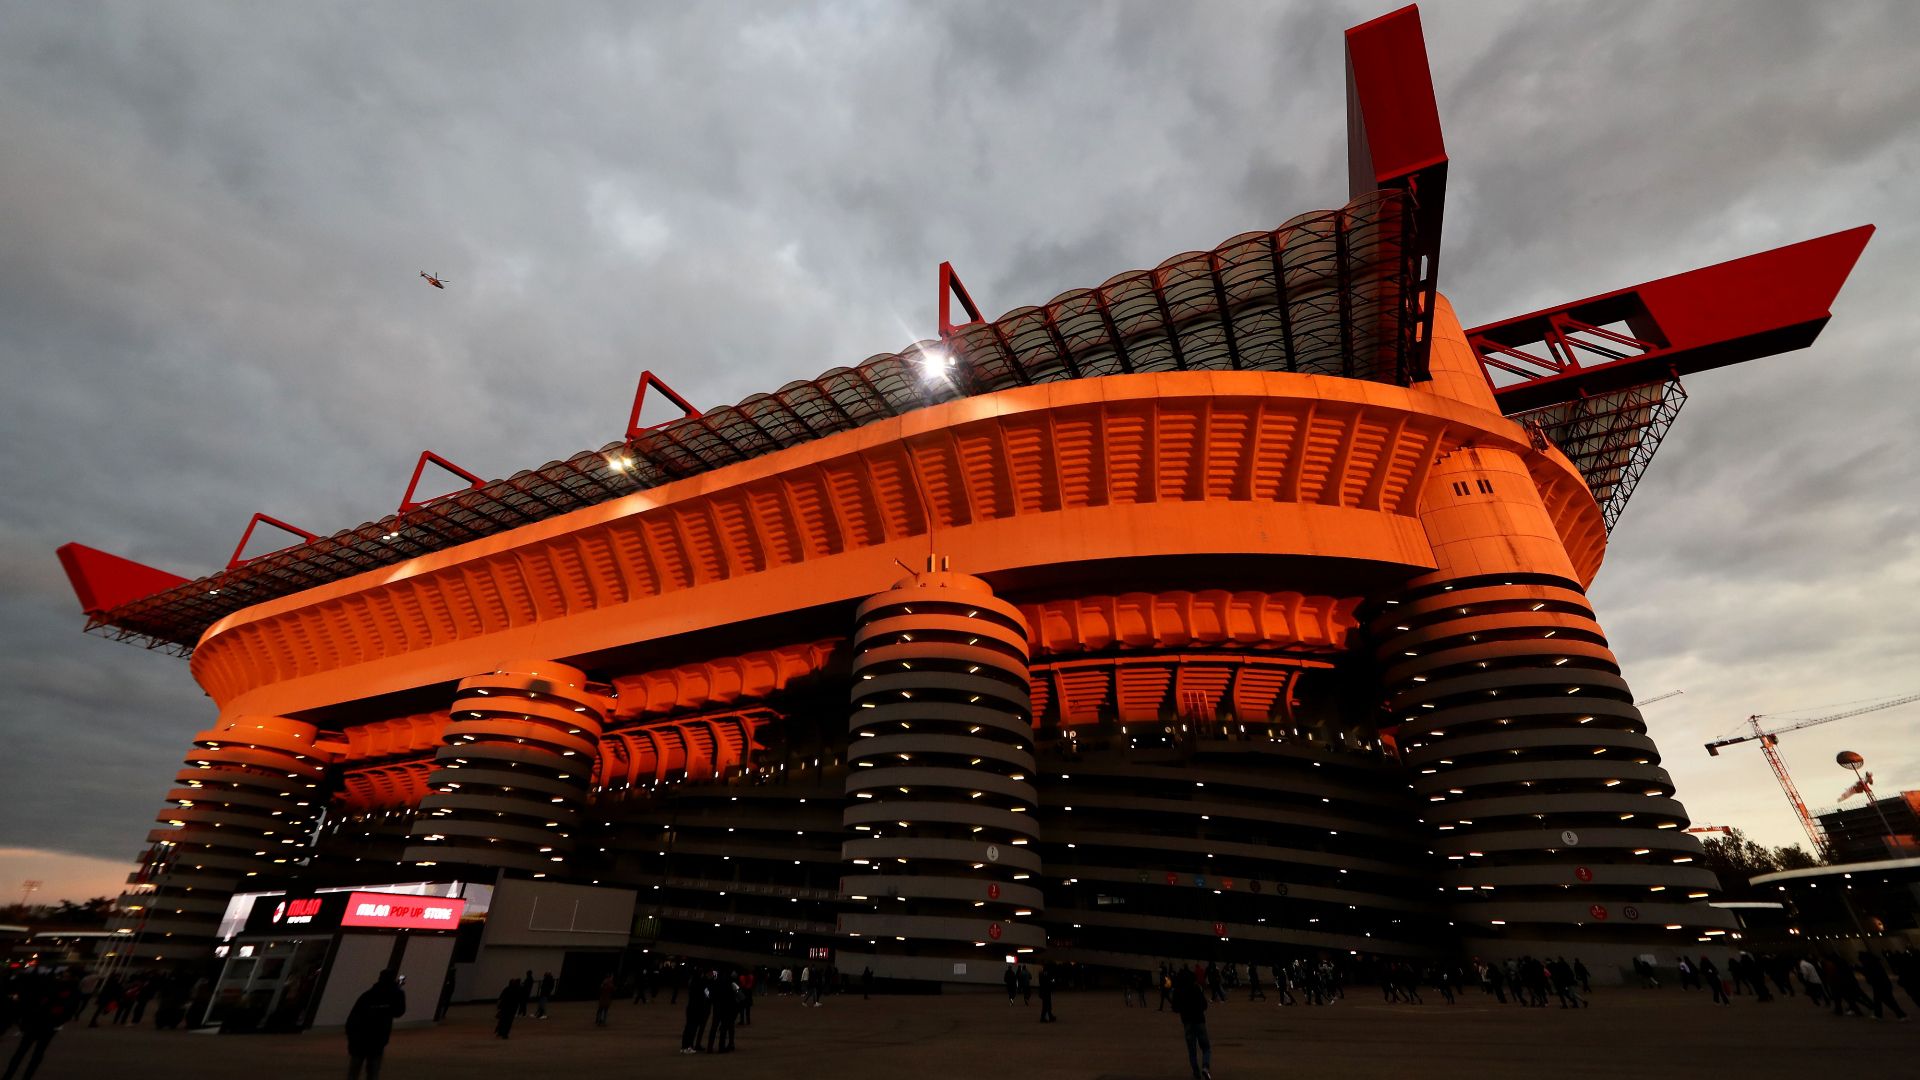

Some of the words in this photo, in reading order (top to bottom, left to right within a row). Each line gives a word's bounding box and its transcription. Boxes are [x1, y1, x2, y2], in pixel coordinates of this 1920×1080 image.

[287, 898, 322, 916] MILAN
[356, 904, 390, 916] MILAN
[391, 906, 408, 916] POP
[410, 908, 423, 918] UP
[423, 907, 453, 920] STORE
